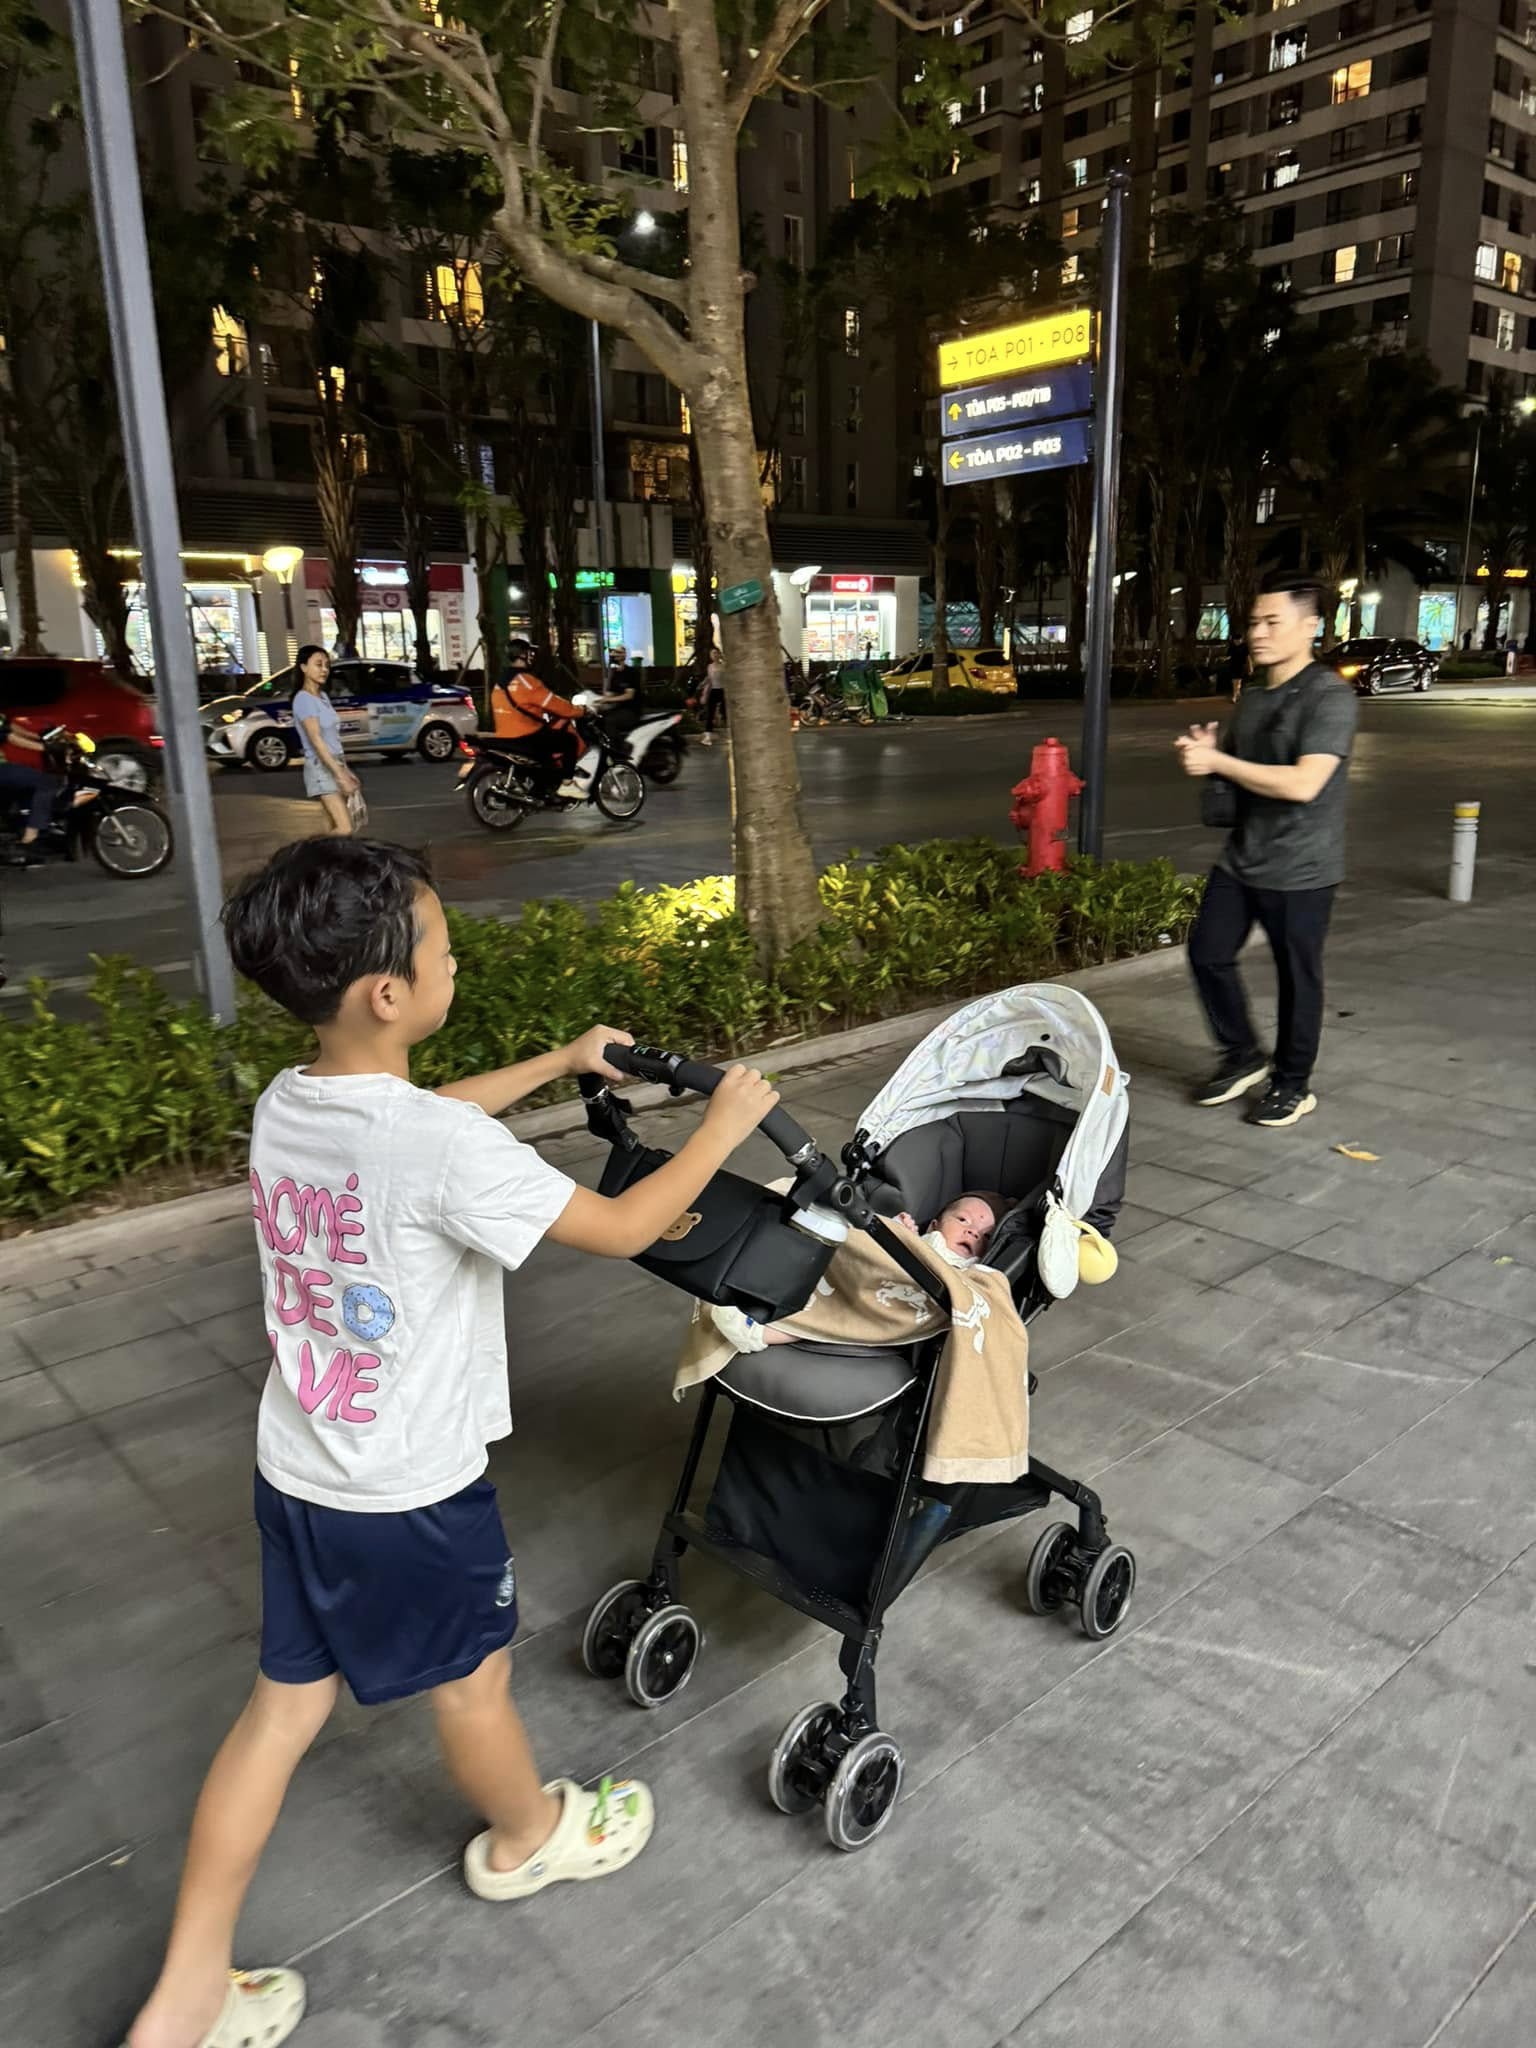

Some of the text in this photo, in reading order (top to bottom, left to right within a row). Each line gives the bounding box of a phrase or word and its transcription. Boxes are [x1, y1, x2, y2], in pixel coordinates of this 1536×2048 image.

[1005, 337, 1034, 359] P01
[1051, 324, 1085, 348] P08
[996, 443, 1024, 463] P02
[1032, 437, 1062, 457] P03
[272, 1256, 338, 1337] DE
[297, 1339, 381, 1424] VIE
